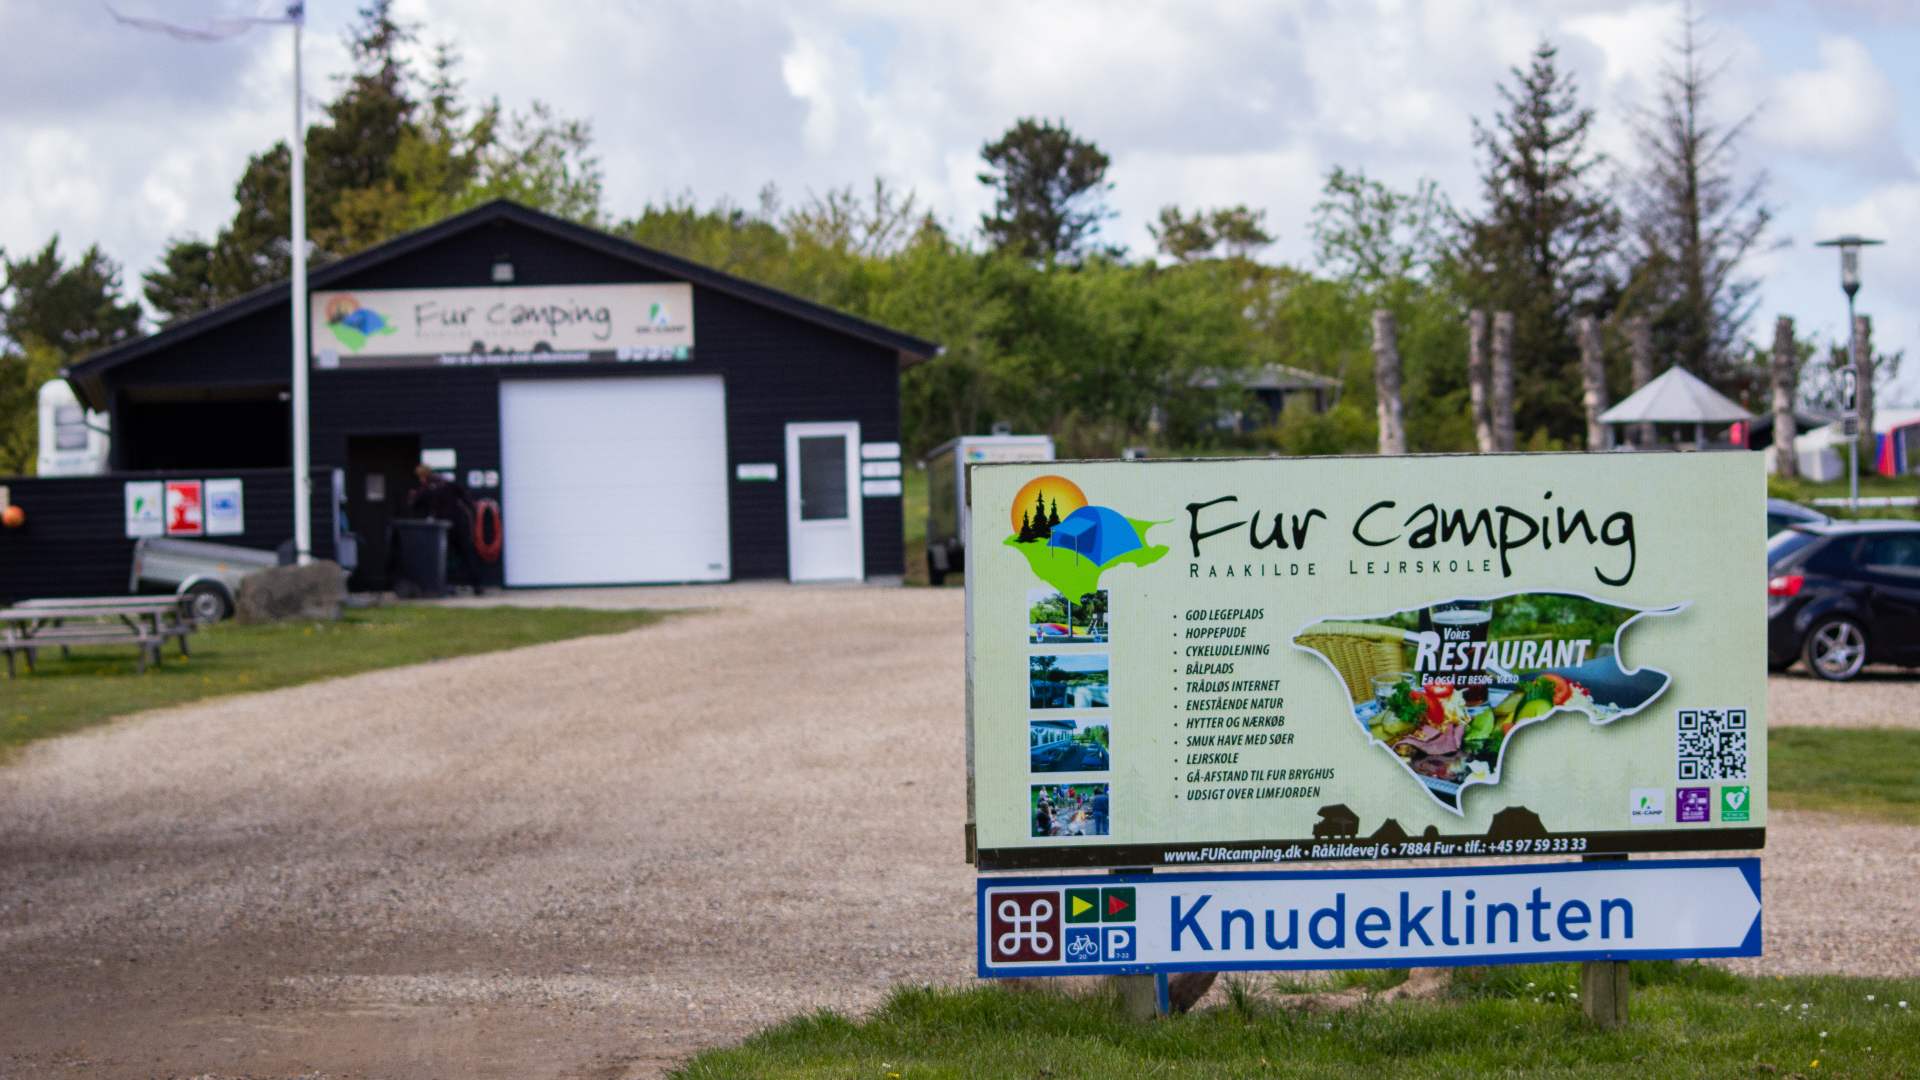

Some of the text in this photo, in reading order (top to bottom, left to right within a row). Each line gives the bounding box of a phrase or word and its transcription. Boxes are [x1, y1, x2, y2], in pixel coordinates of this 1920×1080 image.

[414, 298, 612, 340] Fur Camping
[1186, 490, 1637, 586] Fur Camping
[1190, 560, 1491, 578] RAAKILDE LEJRSKOLE
[1186, 608, 1264, 621] GOD LEGEPLADS
[1186, 627, 1247, 639] HOPPEPUDE
[1186, 644, 1270, 657] CYKELUDLEJNING
[1186, 661, 1235, 675] BÅLPLADS
[1186, 679, 1280, 693] TRÅDLØS INTERNET
[1186, 696, 1284, 711] ENESTÅENDE NATUR
[1186, 716, 1285, 729] HYTTER OG NÆRKØB
[1186, 733, 1294, 747] SMUK HAVE MED SØER
[1186, 752, 1240, 765] LEJRSKOLE
[1187, 768, 1335, 783] GÅ-AFSTAND TIL FUR BRYGHUS
[1187, 786, 1320, 801] UDSIGT OVER LIMFJORDEN
[1164, 837, 1588, 862] www.FURcamping.dk Råkildevej 6 7884 Fur tlf.: +45 97 59 33 33
[1170, 886, 1635, 953] Knudeklinten
[1108, 930, 1130, 959] P
